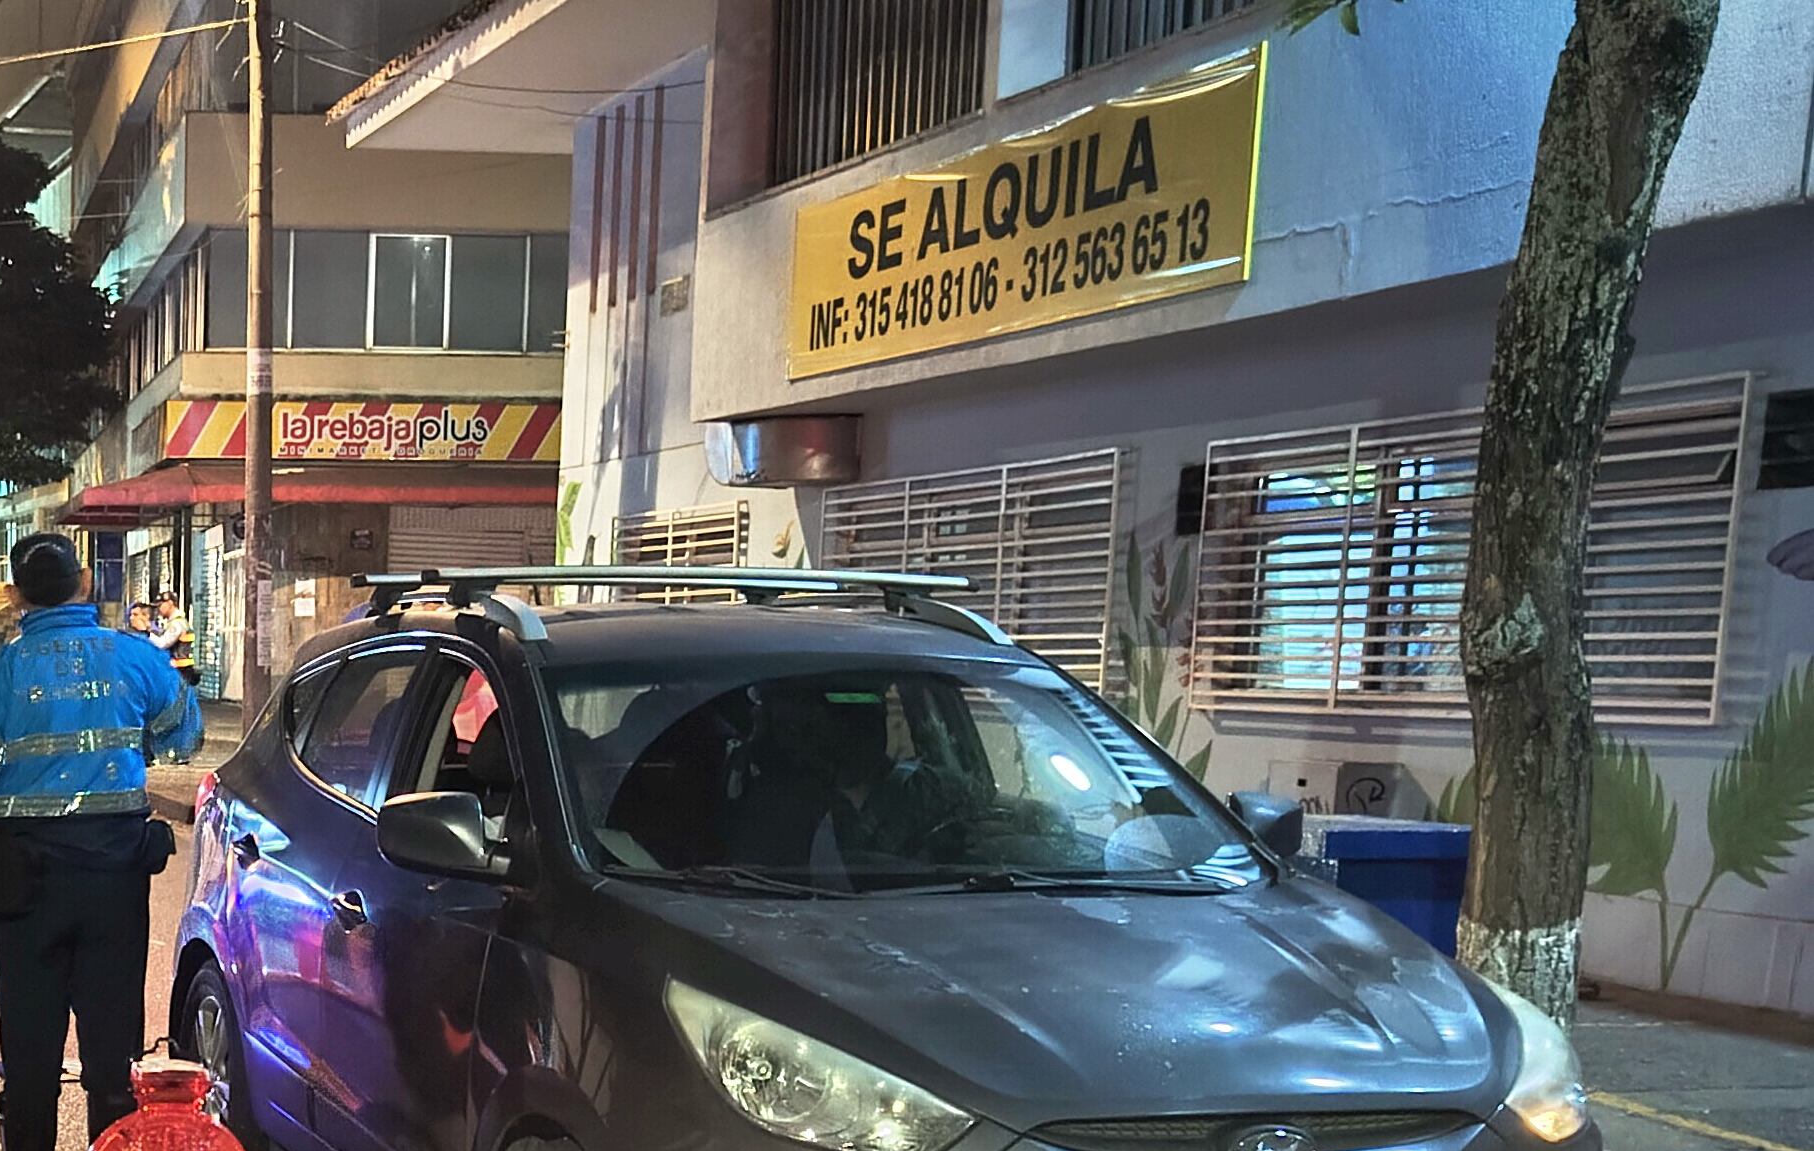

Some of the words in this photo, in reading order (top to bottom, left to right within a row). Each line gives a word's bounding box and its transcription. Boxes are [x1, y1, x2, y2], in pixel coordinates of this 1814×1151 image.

[848, 198, 907, 280] SE
[917, 115, 1159, 261] ALQUILA
[808, 298, 850, 352] INF:
[855, 289, 890, 342] 315
[895, 274, 933, 331] 418
[1022, 237, 1070, 303] 312
[1073, 220, 1125, 290] 563
[1131, 209, 1170, 276] 65
[1176, 197, 1212, 263] 13
[280, 446, 377, 456] MINIMARKET
[316, 413, 412, 450] rebaja
[419, 409, 488, 449] plus
